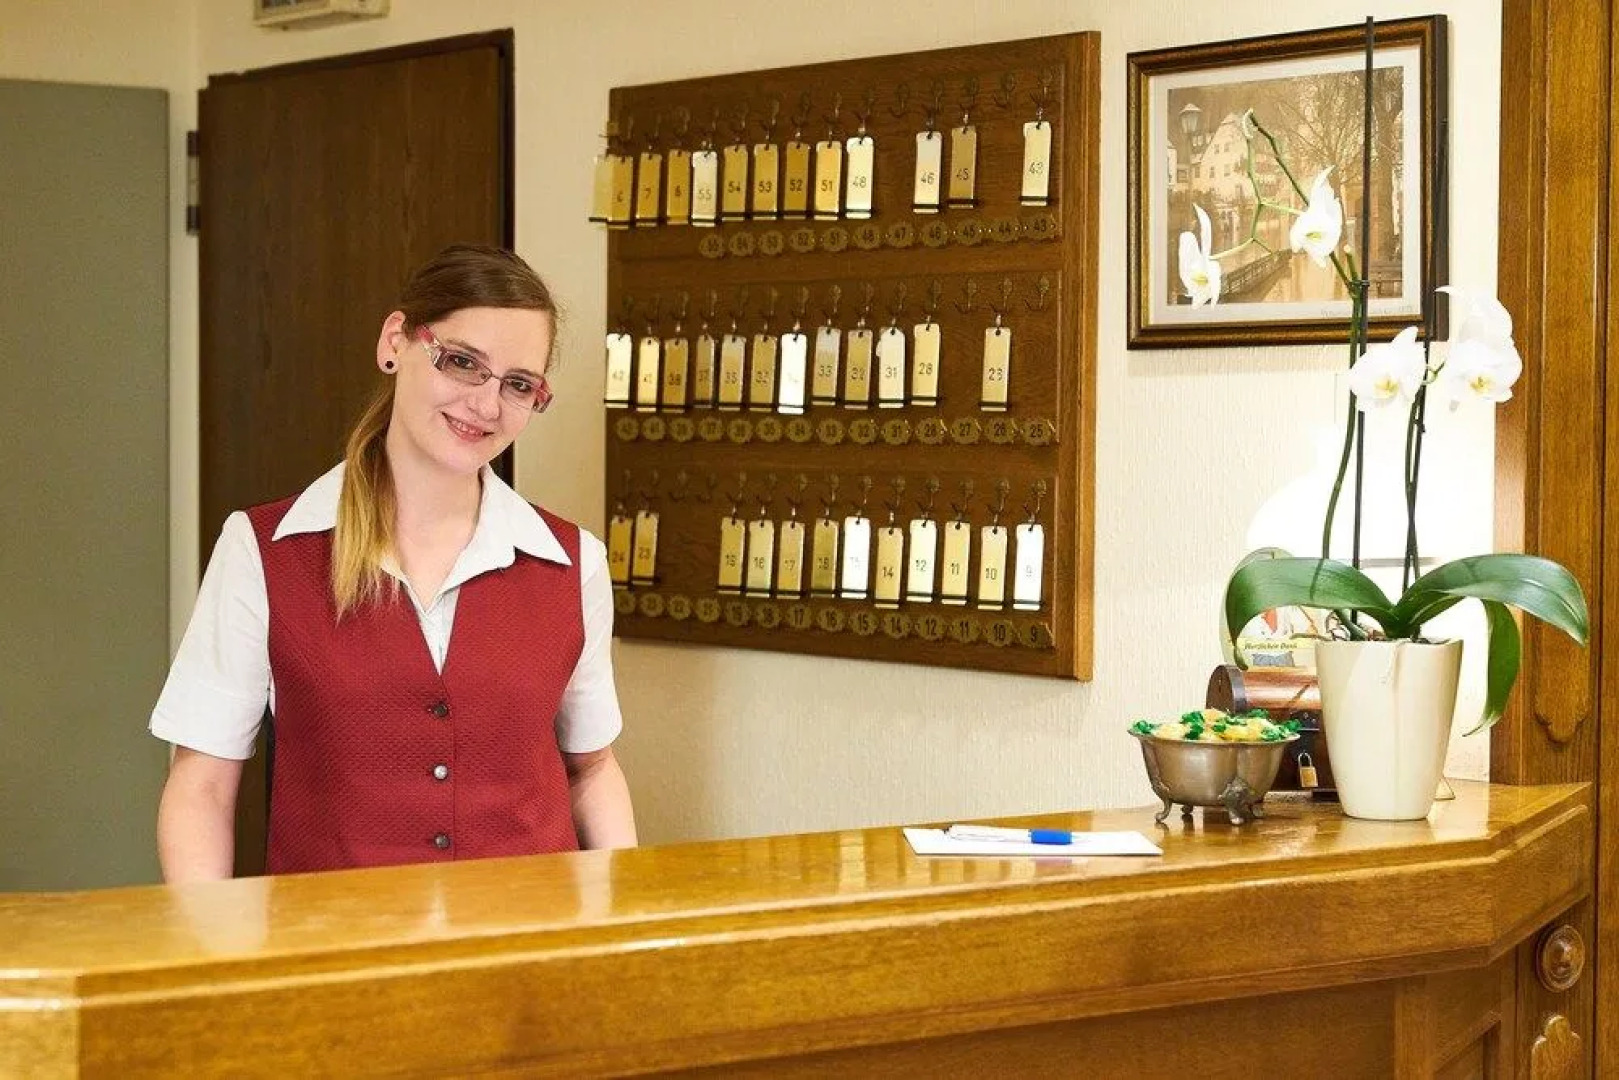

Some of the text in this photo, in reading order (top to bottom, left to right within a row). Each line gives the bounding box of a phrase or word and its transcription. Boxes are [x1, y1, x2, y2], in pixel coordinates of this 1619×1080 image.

[956, 167, 970, 181] 45
[1029, 160, 1044, 175] 43
[789, 179, 804, 192] 52
[852, 175, 867, 189] 48
[920, 171, 936, 185] 46
[758, 180, 773, 194] 53
[820, 179, 834, 193] 51
[697, 187, 713, 201] 55
[962, 224, 977, 238] 45
[998, 221, 1012, 236] 44
[1033, 217, 1048, 233] 43
[894, 227, 907, 243] 47
[928, 226, 942, 241] 46
[818, 364, 834, 378] 33
[884, 365, 899, 379] 31
[918, 361, 934, 376] 28
[959, 423, 973, 438] 27
[993, 422, 1009, 438] 26
[1029, 423, 1045, 439] 25
[753, 556, 766, 570] 16
[915, 558, 928, 573] 12
[950, 562, 961, 577] 11
[881, 565, 895, 580] 14
[984, 567, 999, 582] 10
[793, 607, 807, 624] 17
[856, 613, 870, 630] 15
[890, 616, 904, 634] 14
[924, 618, 938, 636] 12
[959, 620, 971, 637] 11
[993, 623, 1007, 641] 10
[1029, 625, 1038, 641] 9
